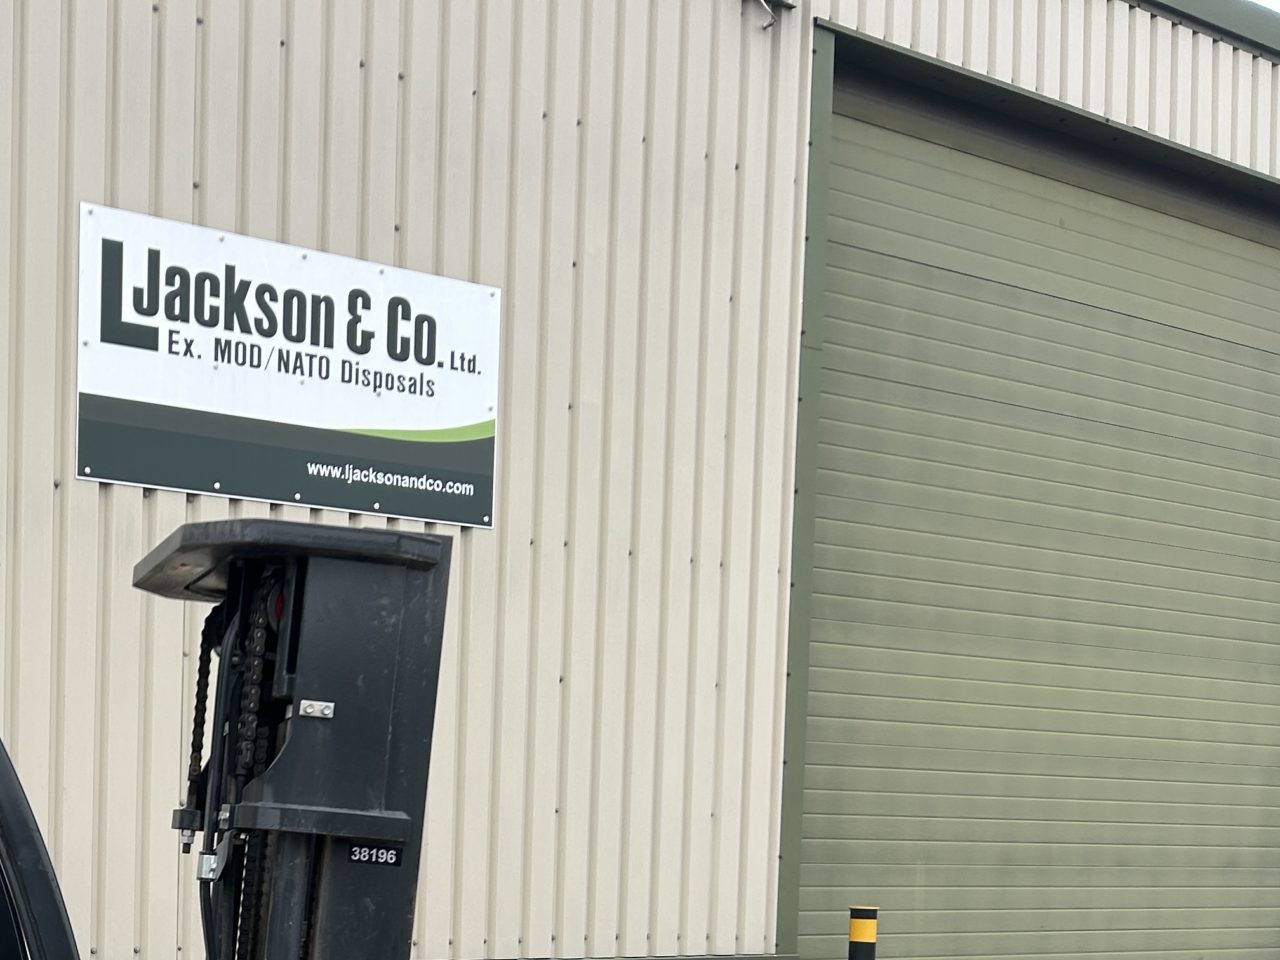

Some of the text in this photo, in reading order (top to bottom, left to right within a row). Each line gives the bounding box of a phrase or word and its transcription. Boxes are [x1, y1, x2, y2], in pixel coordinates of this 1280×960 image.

[346, 288, 376, 356] &
[387, 296, 445, 368] Co.
[450, 350, 482, 376] Ltd.
[168, 330, 436, 398] Ex. MOD/NATO Disposals
[307, 461, 475, 497] www.ljacksonandco.com
[351, 847, 397, 863] 38196
